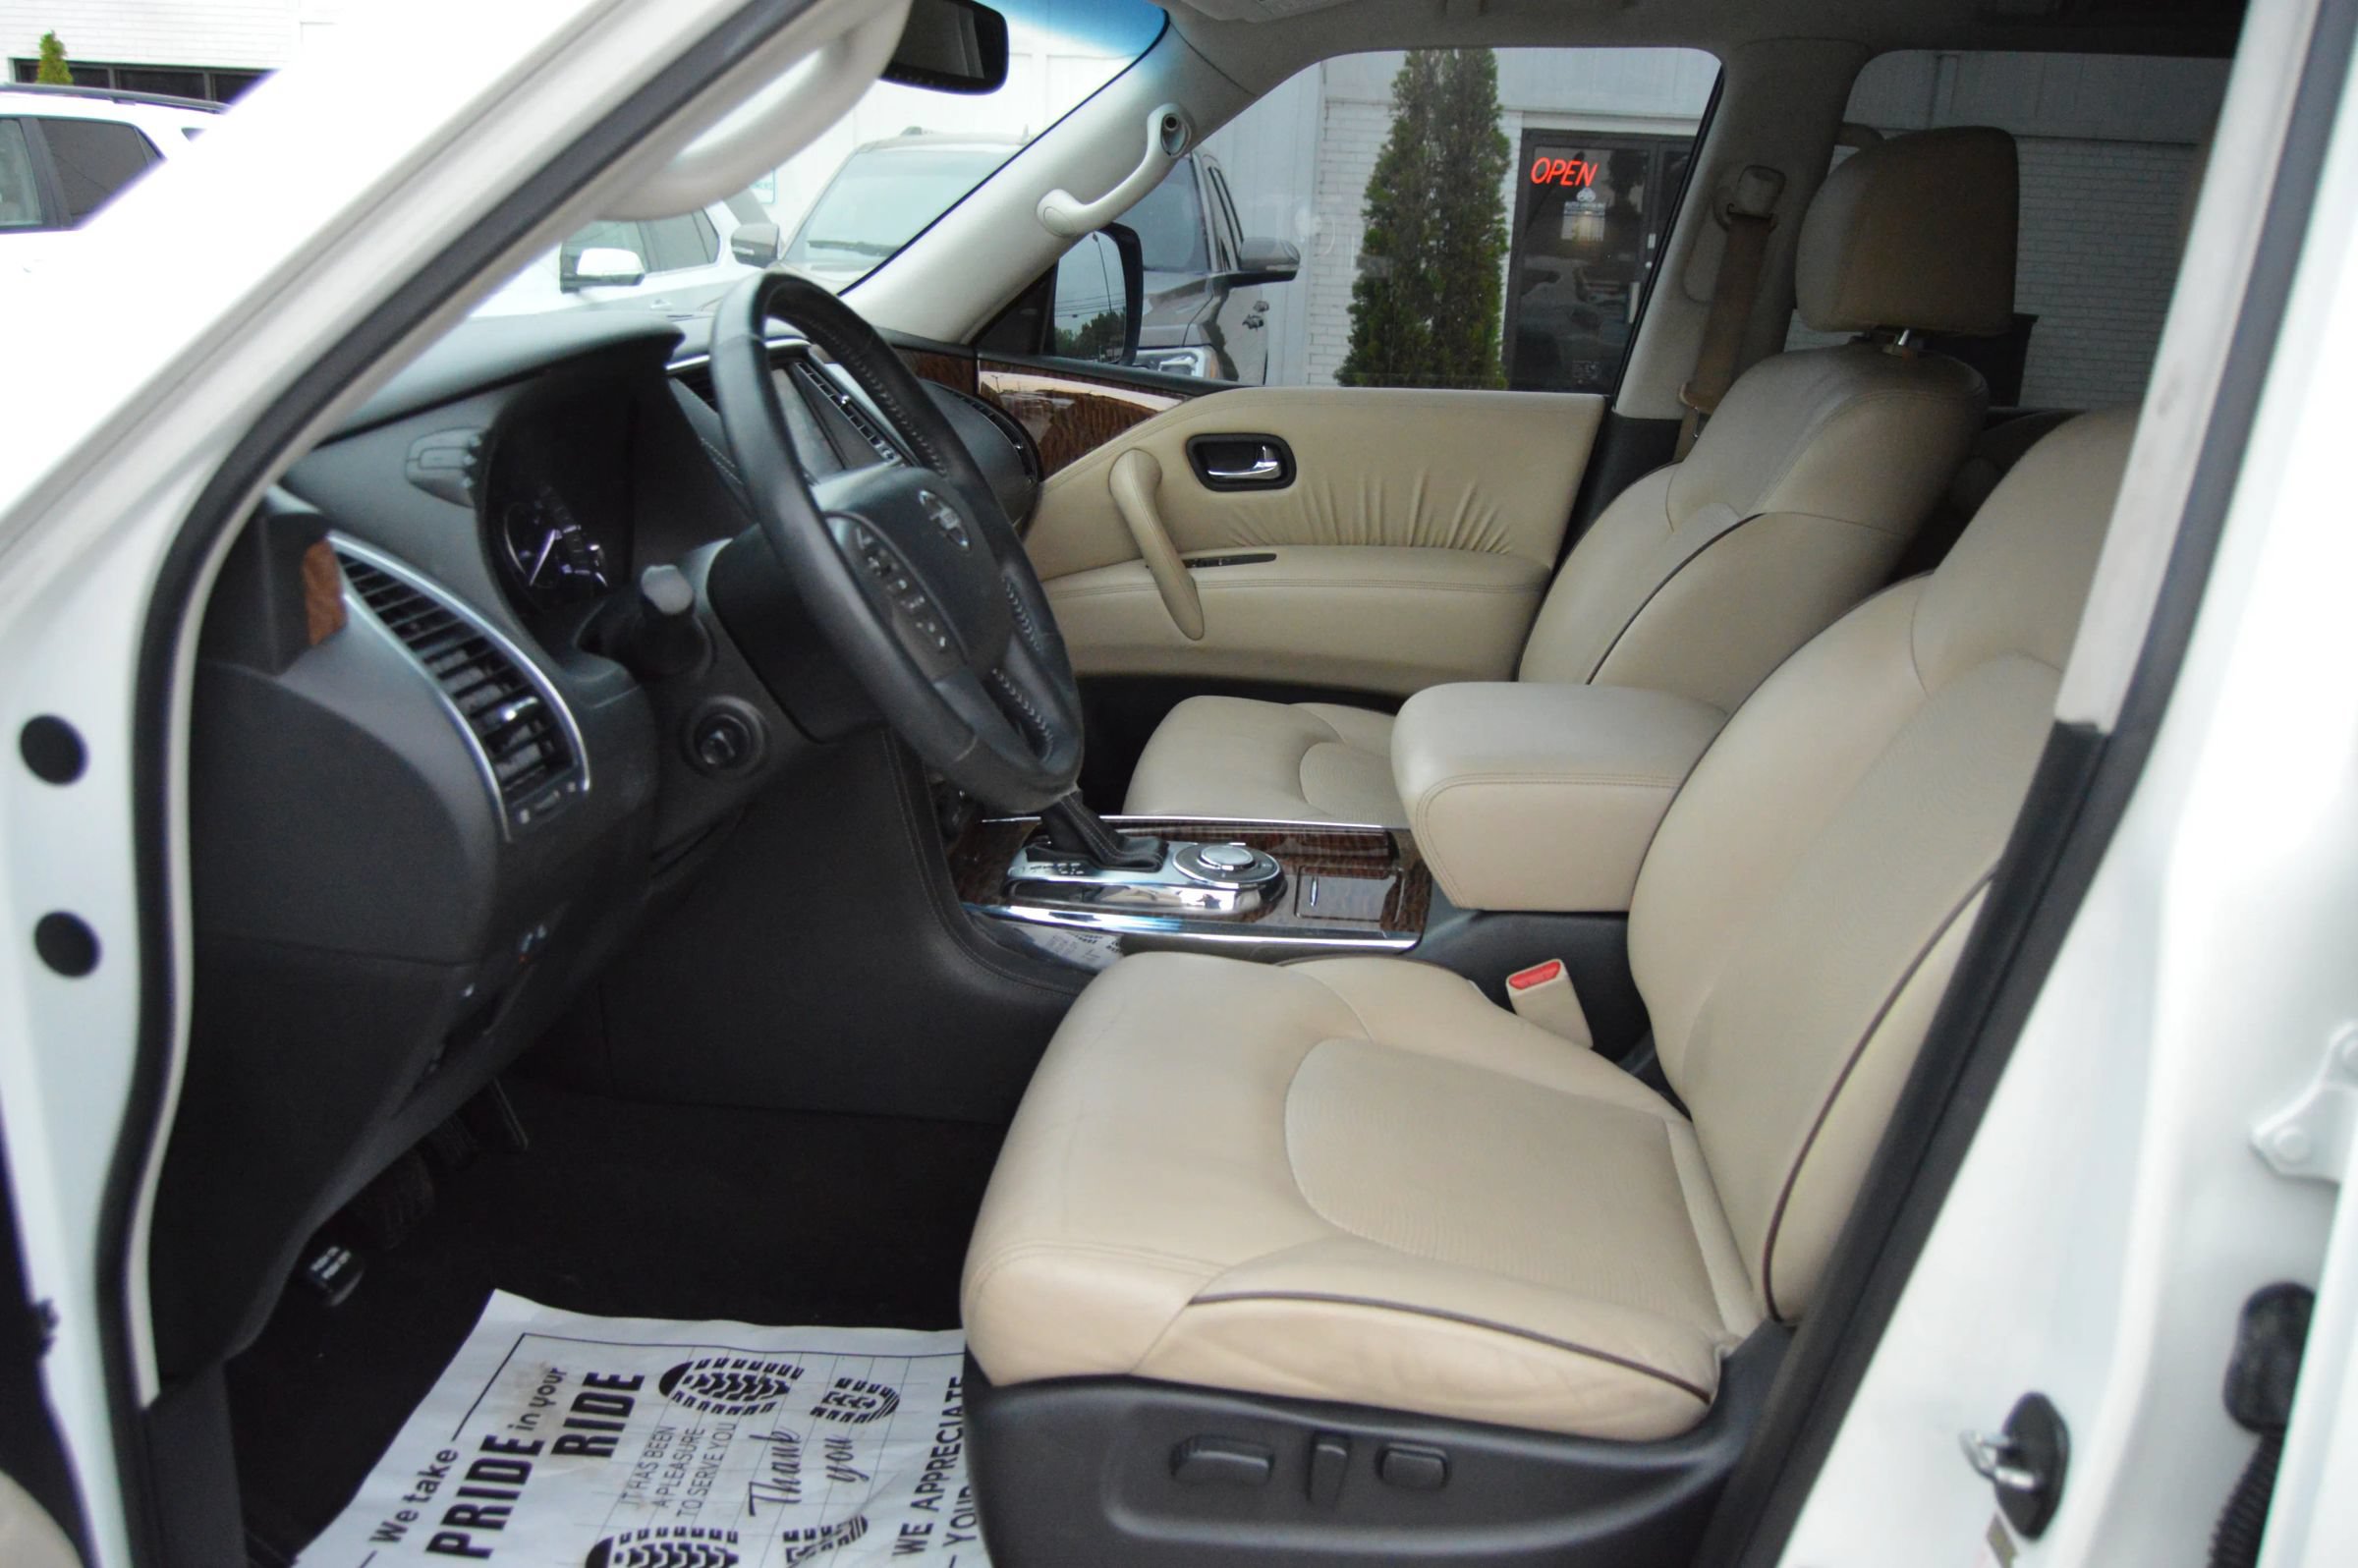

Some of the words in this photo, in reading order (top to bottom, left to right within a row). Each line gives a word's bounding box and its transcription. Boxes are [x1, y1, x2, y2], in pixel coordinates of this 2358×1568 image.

[1530, 156, 1599, 188] OPEN
[550, 1372, 646, 1458] RIDE
[707, 1422, 737, 1454] YOU
[425, 1435, 545, 1558] PRIDE
[507, 1413, 540, 1431] in
[529, 1367, 568, 1408] your
[627, 1461, 659, 1490] HAS
[644, 1426, 677, 1459] BEEN
[655, 1428, 705, 1496] PLEASURE
[687, 1453, 724, 1497] SERVE
[749, 1426, 802, 1517] Thank
[824, 1435, 870, 1483] you
[368, 1509, 420, 1543] We
[401, 1448, 459, 1504] take
[651, 1499, 671, 1509] A
[676, 1499, 702, 1517] TO
[891, 1523, 933, 1556] WE
